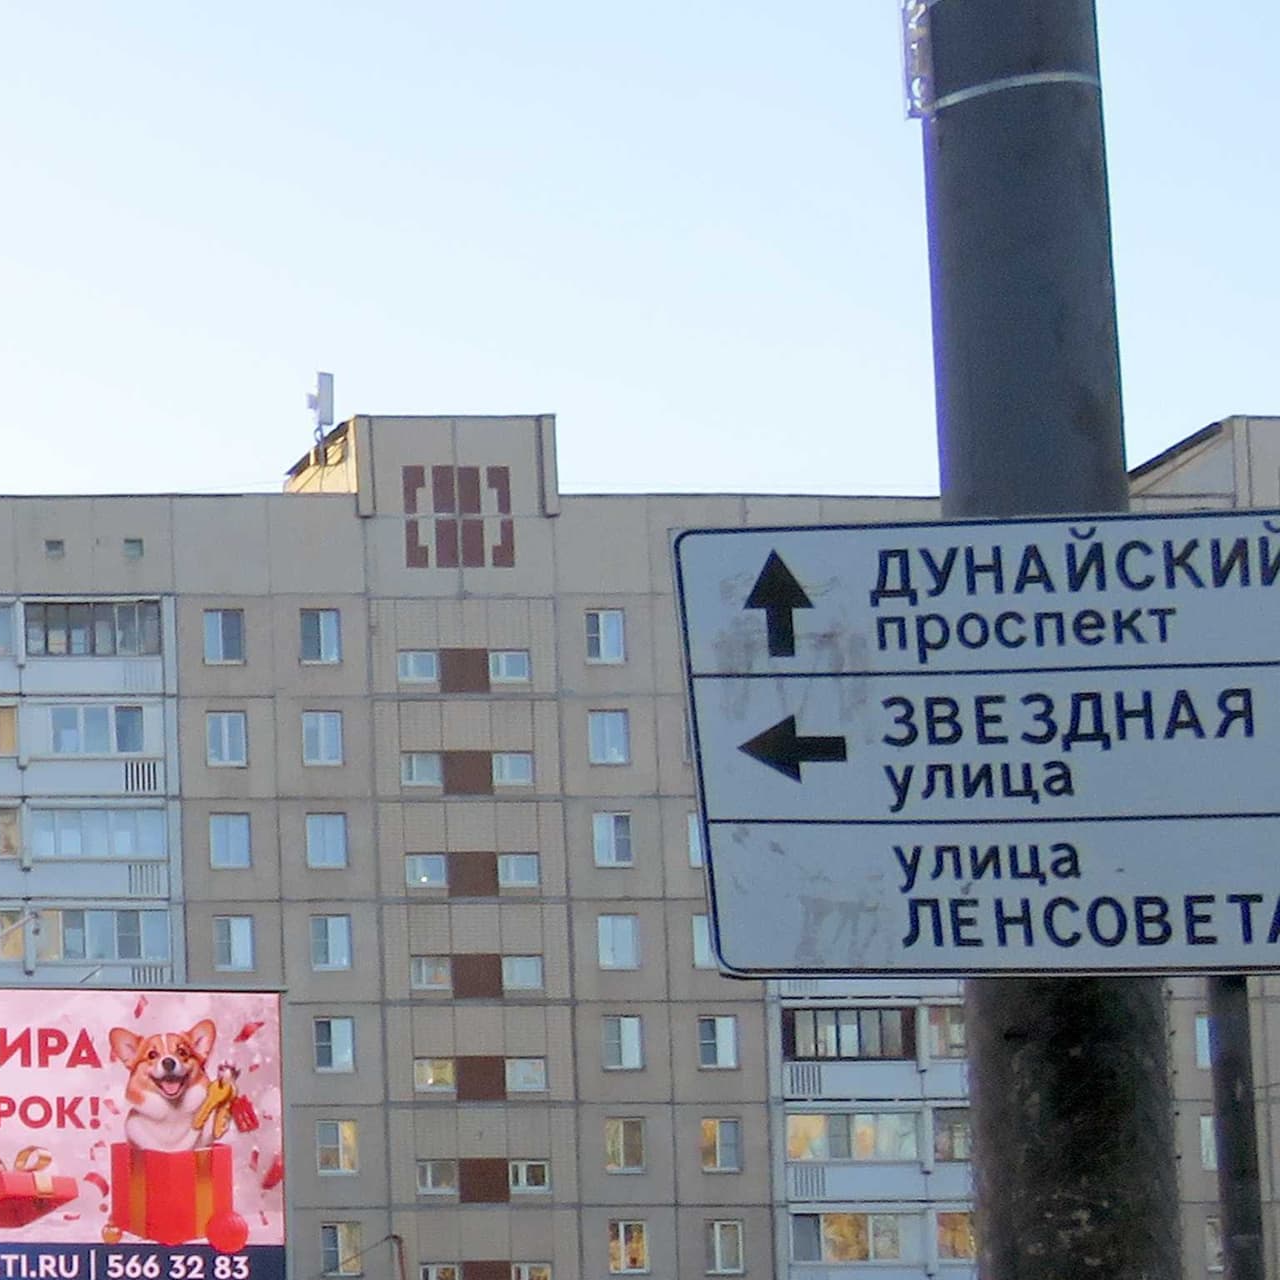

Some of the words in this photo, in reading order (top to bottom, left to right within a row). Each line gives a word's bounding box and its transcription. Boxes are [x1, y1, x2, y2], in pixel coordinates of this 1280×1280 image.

[875, 606, 1177, 664] проспект
[881, 688, 1255, 752] ЗВЕЗДНАЯ
[883, 760, 1075, 813] улица
[892, 842, 1082, 892] улица
[106, 1254, 160, 1279] 566
[169, 1254, 205, 1280] 32
[213, 1255, 250, 1280] 83
